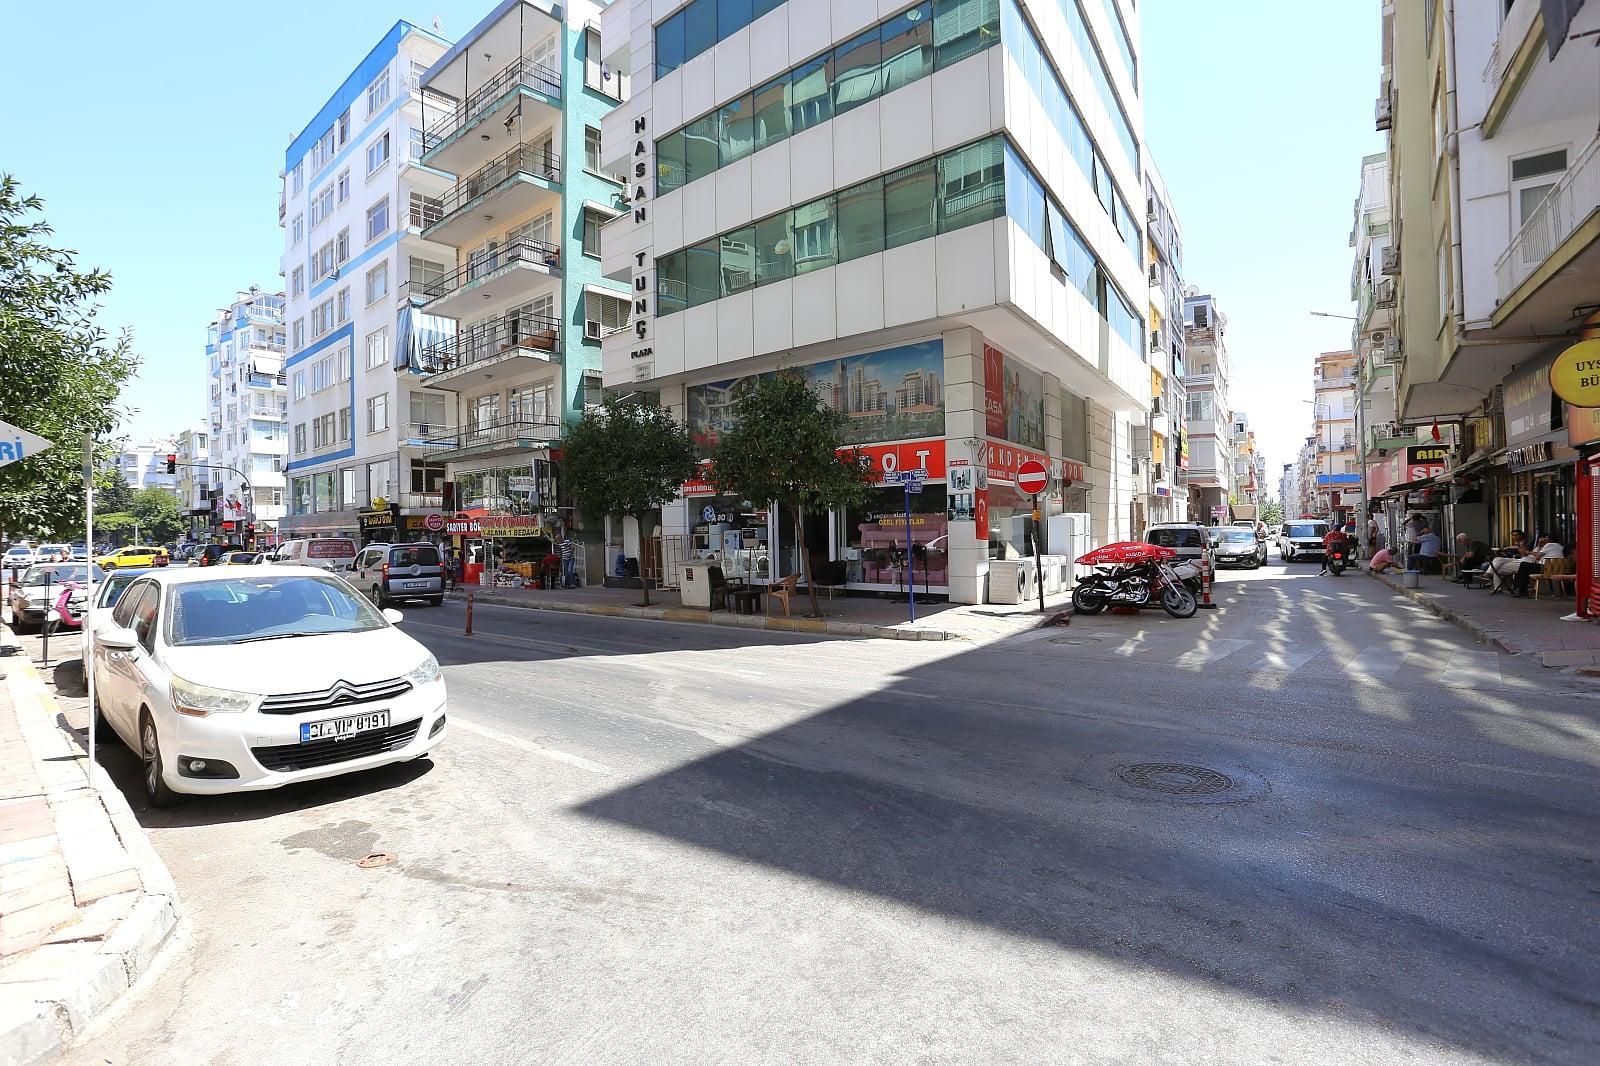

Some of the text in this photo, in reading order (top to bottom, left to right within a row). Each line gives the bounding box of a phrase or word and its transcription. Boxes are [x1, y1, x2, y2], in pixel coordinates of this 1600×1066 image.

[634, 116, 646, 339] HASAN TUNÇ
[631, 347, 653, 359] PLAZA
[1580, 374, 1600, 387] BÜ
[446, 522, 468, 532] SARIYER
[895, 517, 925, 526] FİYTLAR
